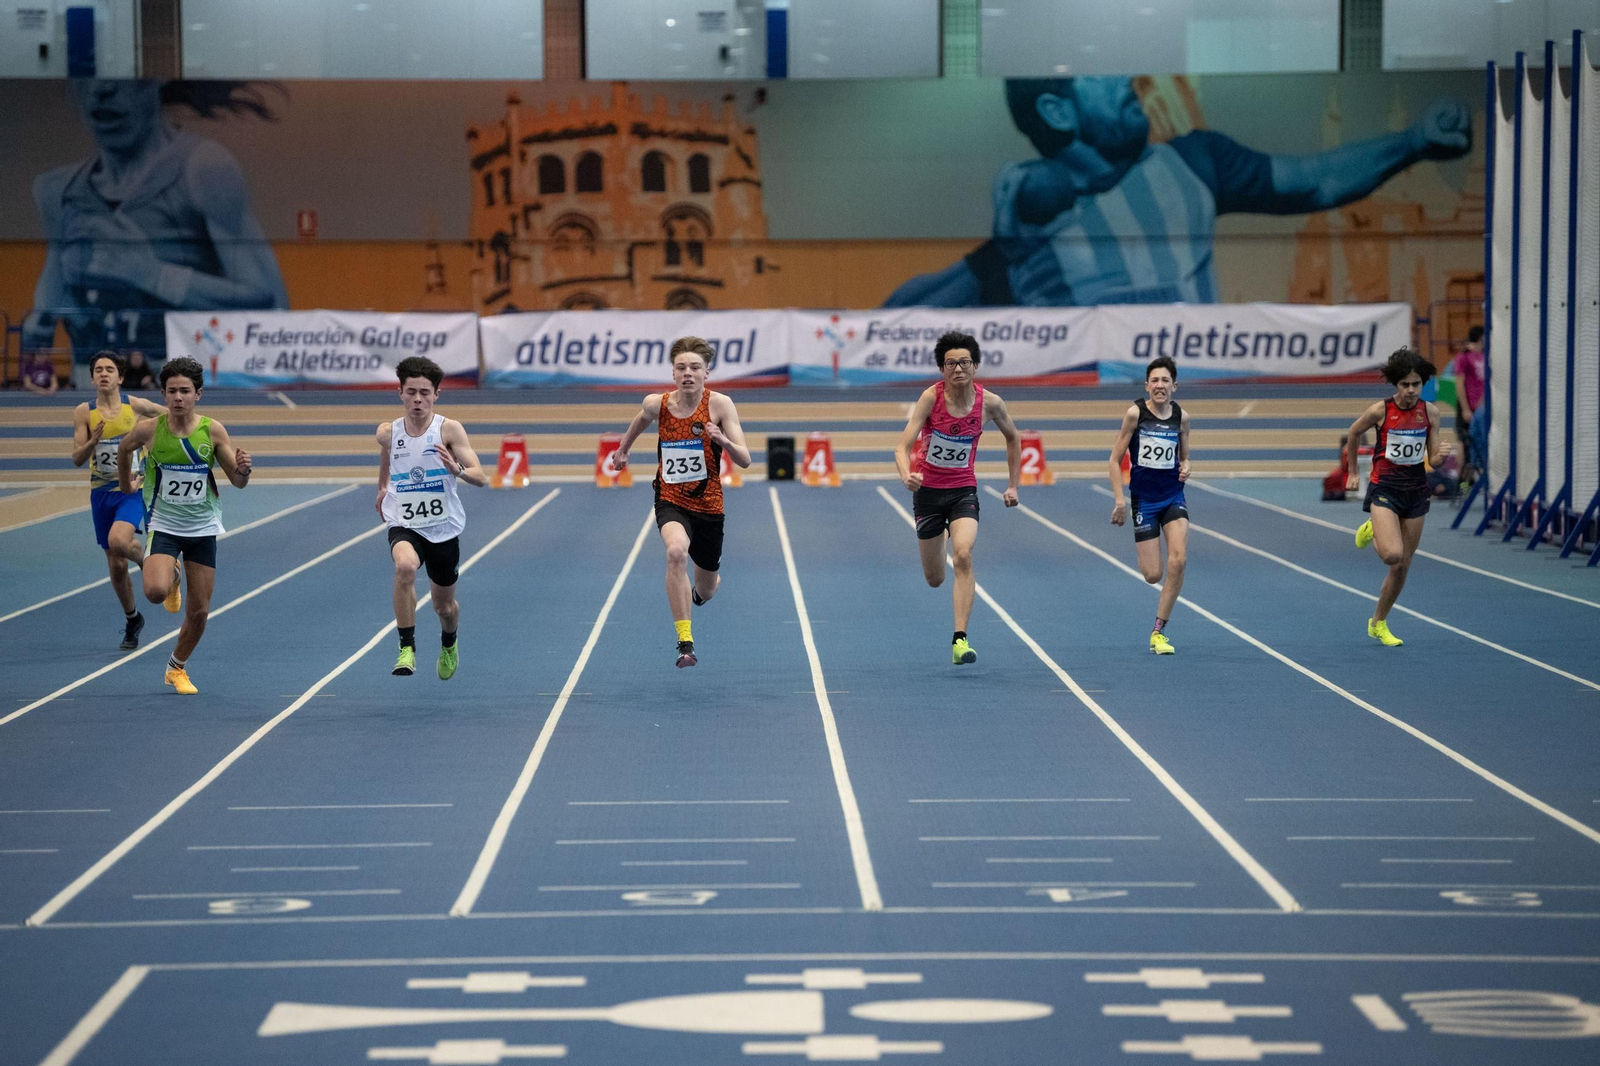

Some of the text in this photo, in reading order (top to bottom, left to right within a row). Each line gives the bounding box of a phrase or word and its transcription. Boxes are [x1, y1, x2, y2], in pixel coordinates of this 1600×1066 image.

[244, 323, 447, 352] Federación Galega
[981, 320, 1069, 346] Galega
[1132, 323, 1378, 366] atletismo.gal
[244, 351, 382, 371] de Atletismo
[864, 350, 887, 366] de
[931, 444, 967, 462] 236
[1020, 446, 1041, 474] 2
[1142, 445, 1174, 461] 290
[1390, 442, 1423, 458] 309
[503, 450, 523, 479] 7
[665, 455, 702, 475] 233
[807, 448, 828, 475] 4
[168, 479, 203, 497] 279
[396, 481, 443, 492] OURENSE 2026
[401, 498, 444, 520] 348
